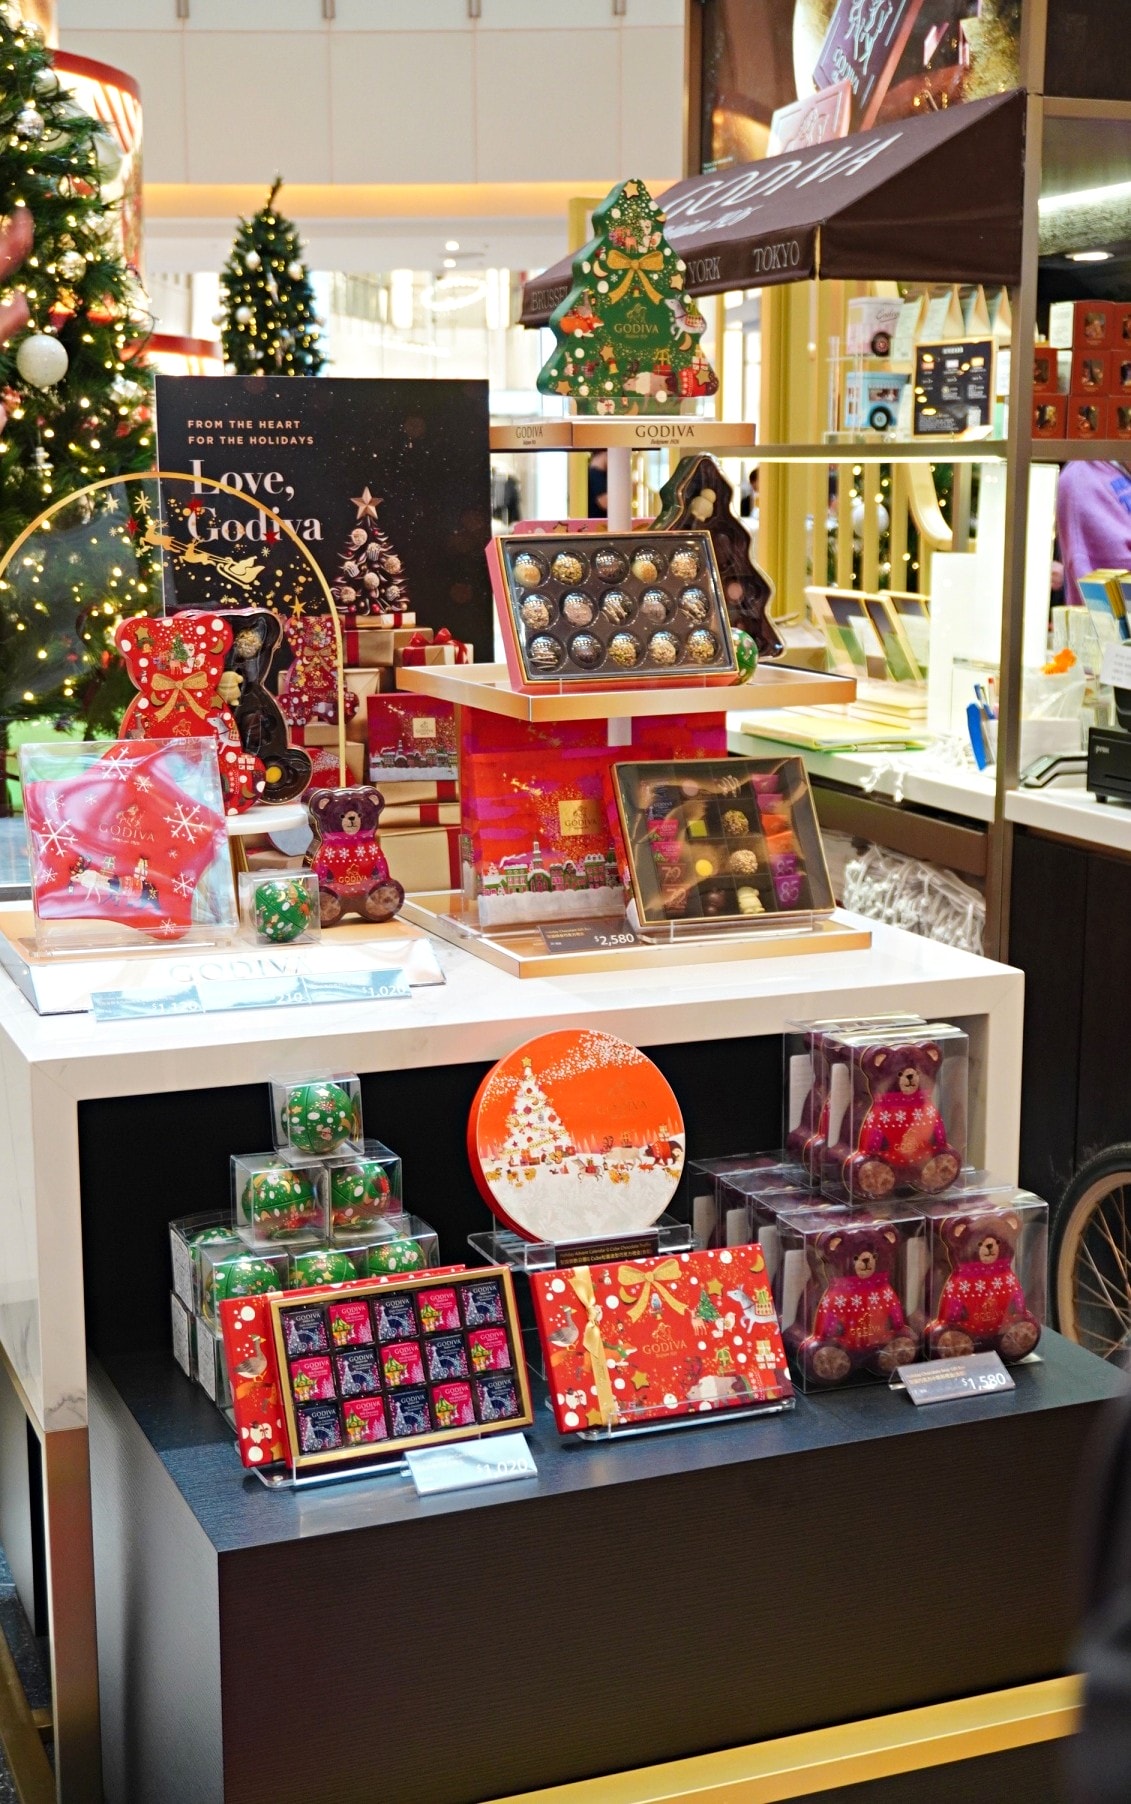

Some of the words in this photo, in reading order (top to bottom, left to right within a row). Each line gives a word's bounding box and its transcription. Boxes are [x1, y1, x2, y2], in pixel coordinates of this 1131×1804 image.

[661, 132, 903, 219] GODIVA
[752, 240, 800, 272] TOKYO
[687, 256, 721, 284] YORK
[613, 323, 659, 333] GODIVA
[187, 420, 223, 429] FROM
[229, 420, 253, 429] THE
[259, 420, 301, 429] HEART
[515, 426, 543, 438] GODIVA
[635, 425, 695, 438] GODIVA
[188, 436, 214, 445] FOR
[220, 436, 244, 445] THE
[250, 436, 314, 445] HOLIDAYS
[188, 459, 295, 501] Love,
[187, 506, 324, 543] Godiva
[564, 819, 597, 827] GODIVA
[98, 823, 155, 843] GODIVA
[338, 875, 368, 884] GODIVA
[780, 880, 800, 903] 85
[593, 933, 635, 946] $2,580
[473, 1285, 497, 1293] GODIVA
[430, 1293, 454, 1301] GODIVA
[386, 1298, 410, 1307] GODIVA
[342, 1306, 366, 1314] GODIVA
[296, 1313, 320, 1321] GODIVA
[480, 1332, 504, 1340] GODIVA
[437, 1339, 461, 1347] GODIVA
[642, 1339, 688, 1355] GODIVA
[394, 1346, 419, 1355] GODIVA
[349, 1354, 374, 1362] GODIVA
[304, 1361, 330, 1369] GODIVA
[488, 1379, 512, 1388] GODIVA
[961, 1372, 1006, 1391] $1,580
[445, 1386, 469, 1394] GODIVA
[401, 1394, 425, 1403] GODIVA
[356, 1401, 381, 1409] GODIVA
[312, 1409, 336, 1418] GODIVA
